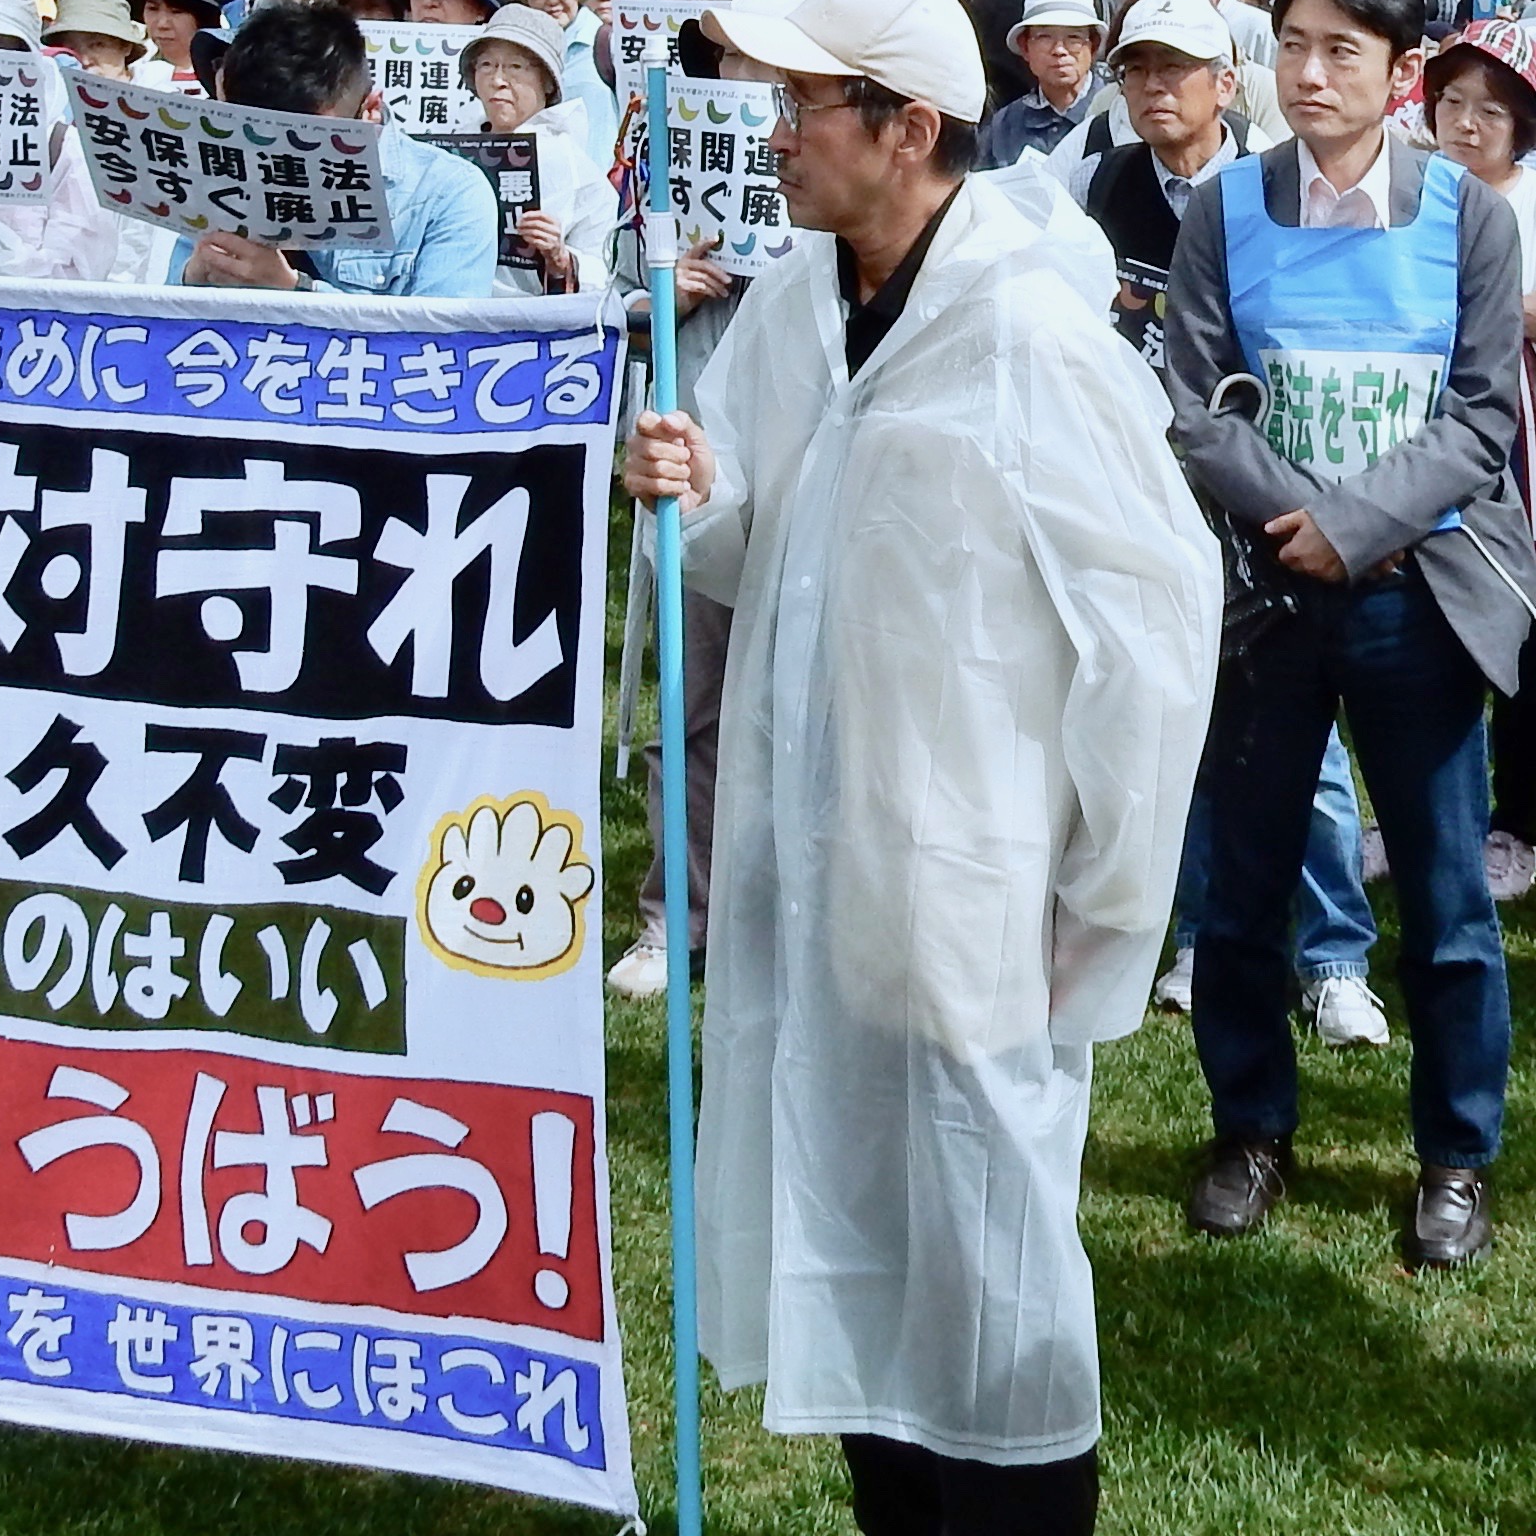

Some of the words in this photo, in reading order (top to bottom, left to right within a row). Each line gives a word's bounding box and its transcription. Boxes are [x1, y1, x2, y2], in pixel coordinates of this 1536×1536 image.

[84, 110, 371, 194] 安保関連法
[94, 151, 379, 225] 今すぐ廃止
[166, 326, 604, 429] 今を生きてる
[107, 1301, 592, 1456] 世界にほこれ
